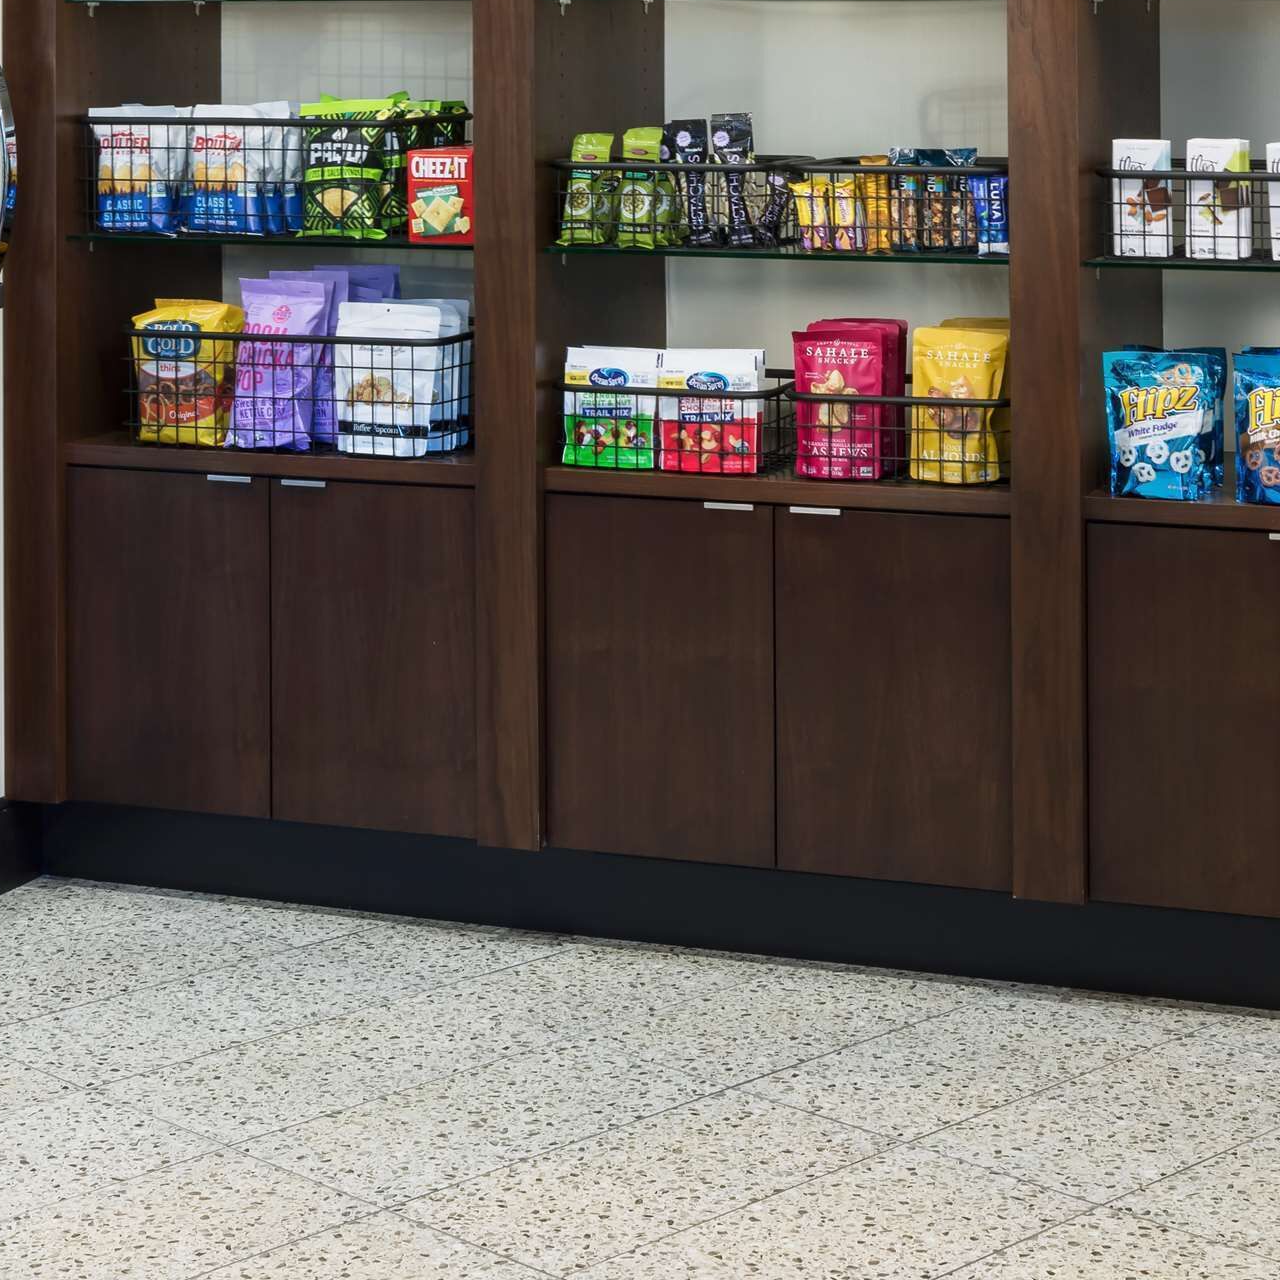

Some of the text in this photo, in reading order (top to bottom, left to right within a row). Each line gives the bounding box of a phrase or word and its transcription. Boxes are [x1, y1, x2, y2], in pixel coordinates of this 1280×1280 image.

[990, 182, 999, 220] LUNA
[806, 346, 869, 359] SAHALE
[926, 350, 992, 363] SAHALE
[817, 357, 856, 365] SNACKS
[584, 409, 611, 417] TRAIL
[1119, 385, 1199, 428] Flipz
[1127, 425, 1151, 438] White
[1151, 422, 1177, 435] Fudge
[1249, 430, 1268, 443] Milk
